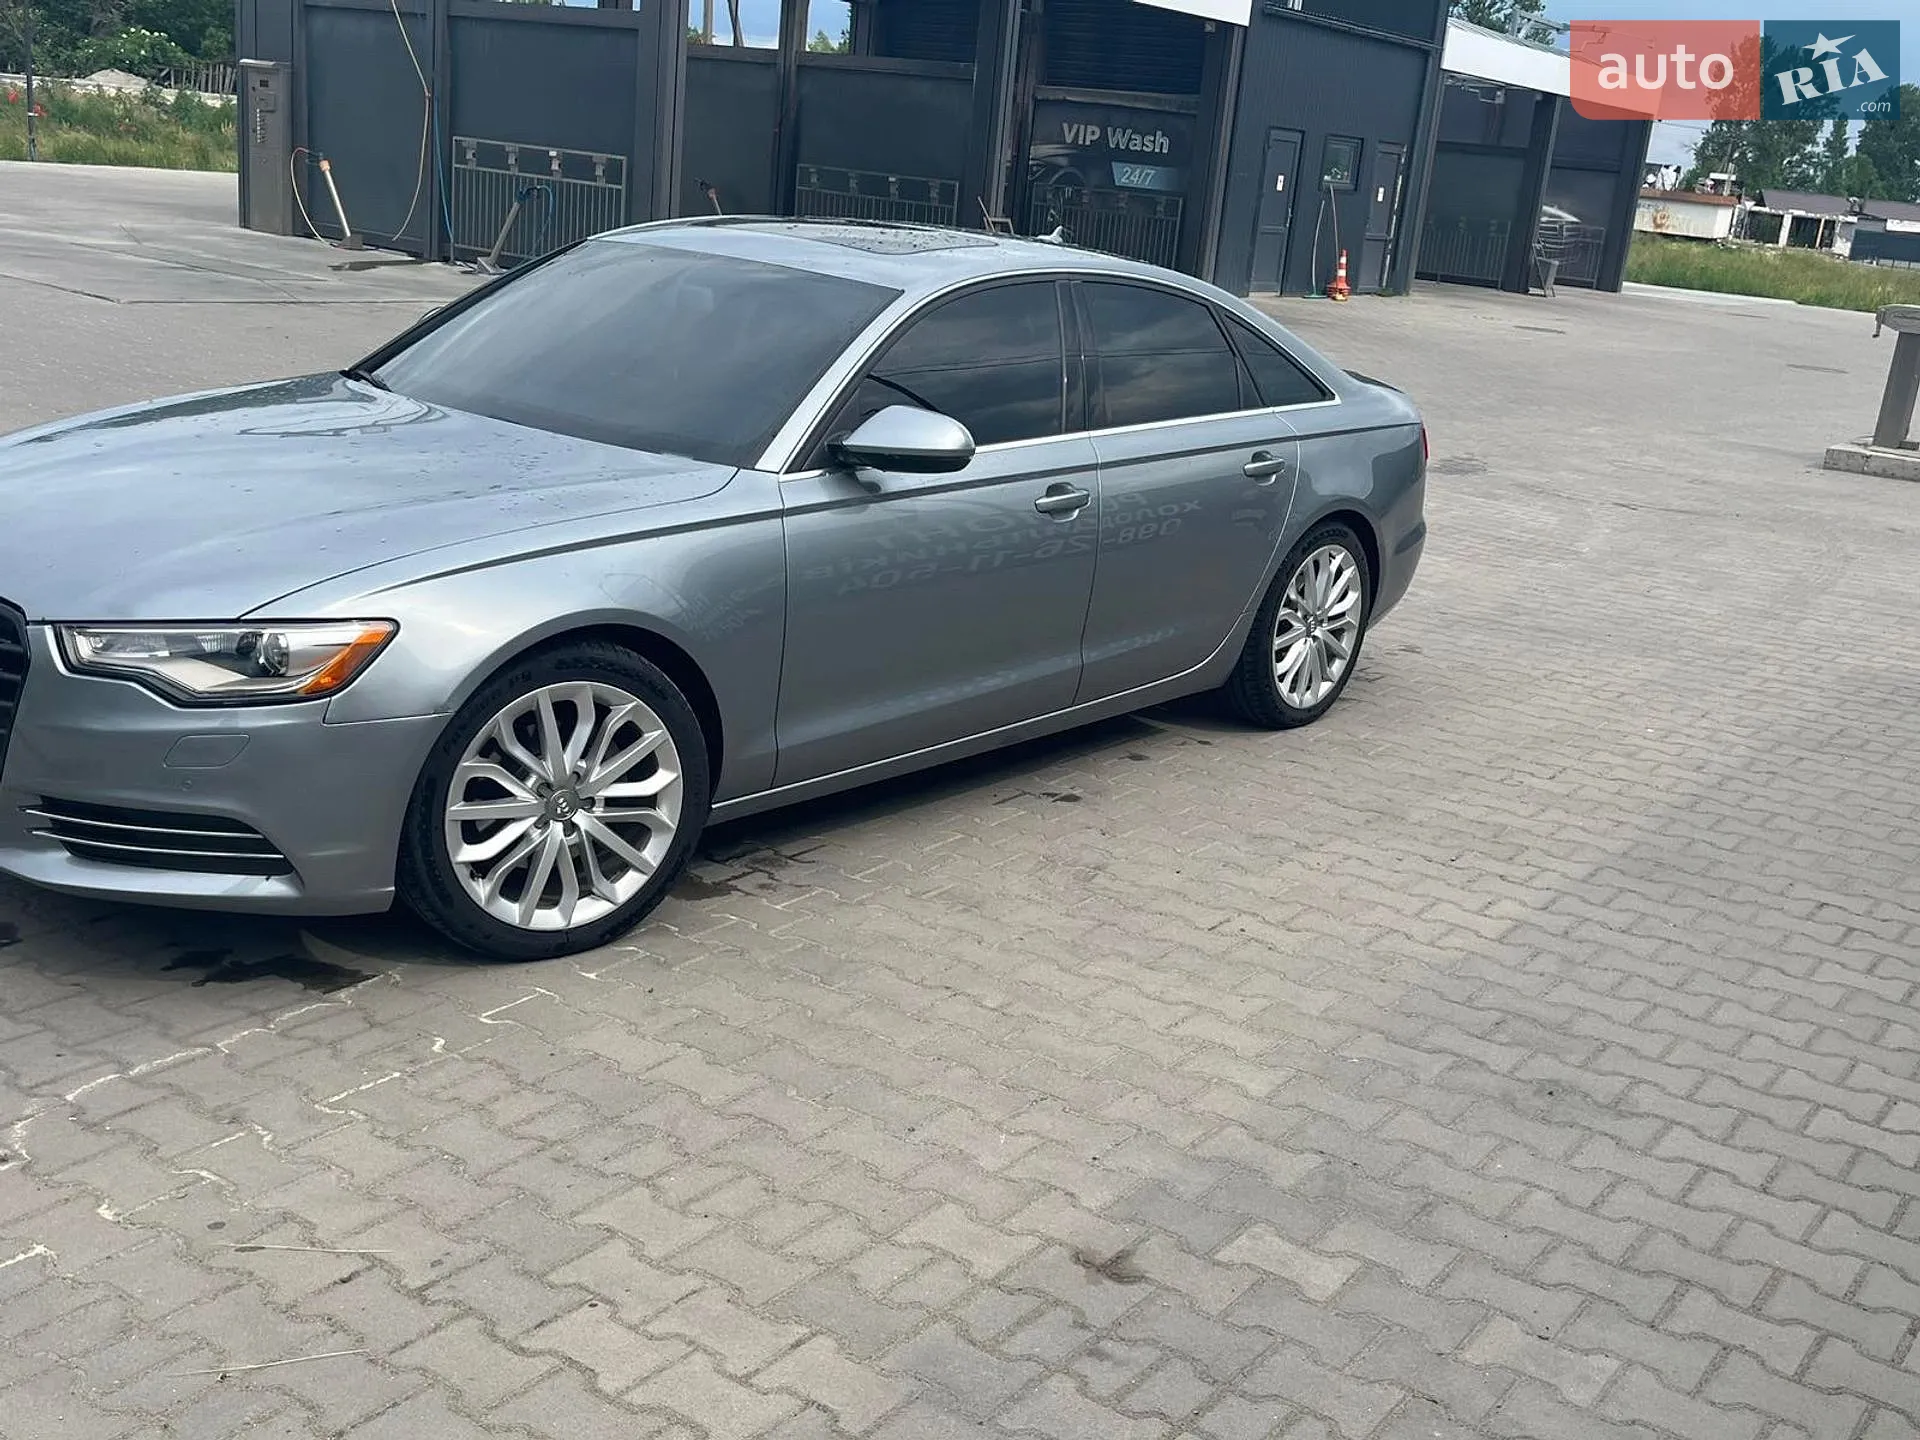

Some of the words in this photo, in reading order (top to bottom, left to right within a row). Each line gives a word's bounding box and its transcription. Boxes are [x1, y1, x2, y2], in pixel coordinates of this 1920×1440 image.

[1062, 123, 1100, 145] VIP
[1107, 127, 1169, 153] Wash
[1121, 167, 1156, 185] 24/7
